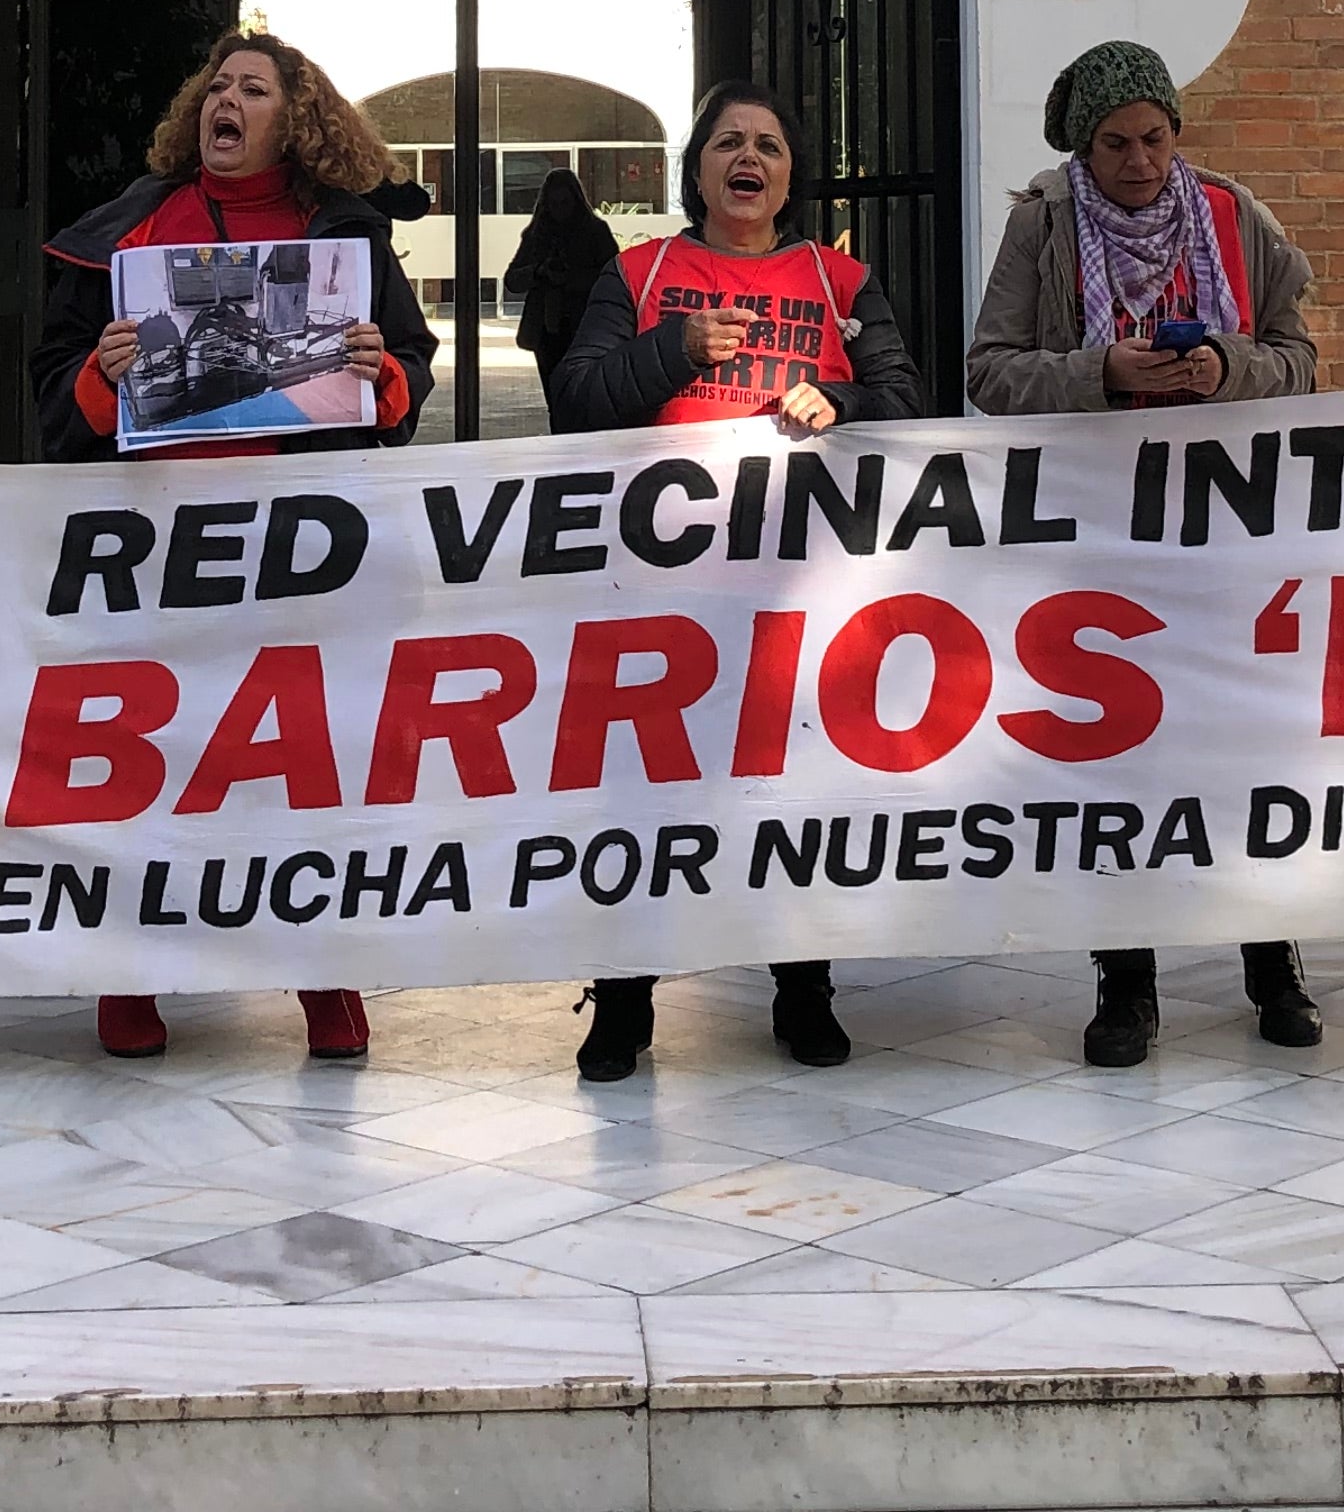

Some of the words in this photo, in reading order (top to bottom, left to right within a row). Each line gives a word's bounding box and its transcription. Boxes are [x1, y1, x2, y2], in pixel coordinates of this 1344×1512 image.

[659, 286, 728, 310] SOY
[780, 296, 826, 326] UN
[46, 495, 368, 616] RED
[423, 447, 1076, 583] VECINAL
[5, 591, 1165, 828] BARRIOS
[139, 842, 471, 929] LUCHA
[510, 825, 718, 908] POR
[749, 797, 1213, 888] NUESTRA
